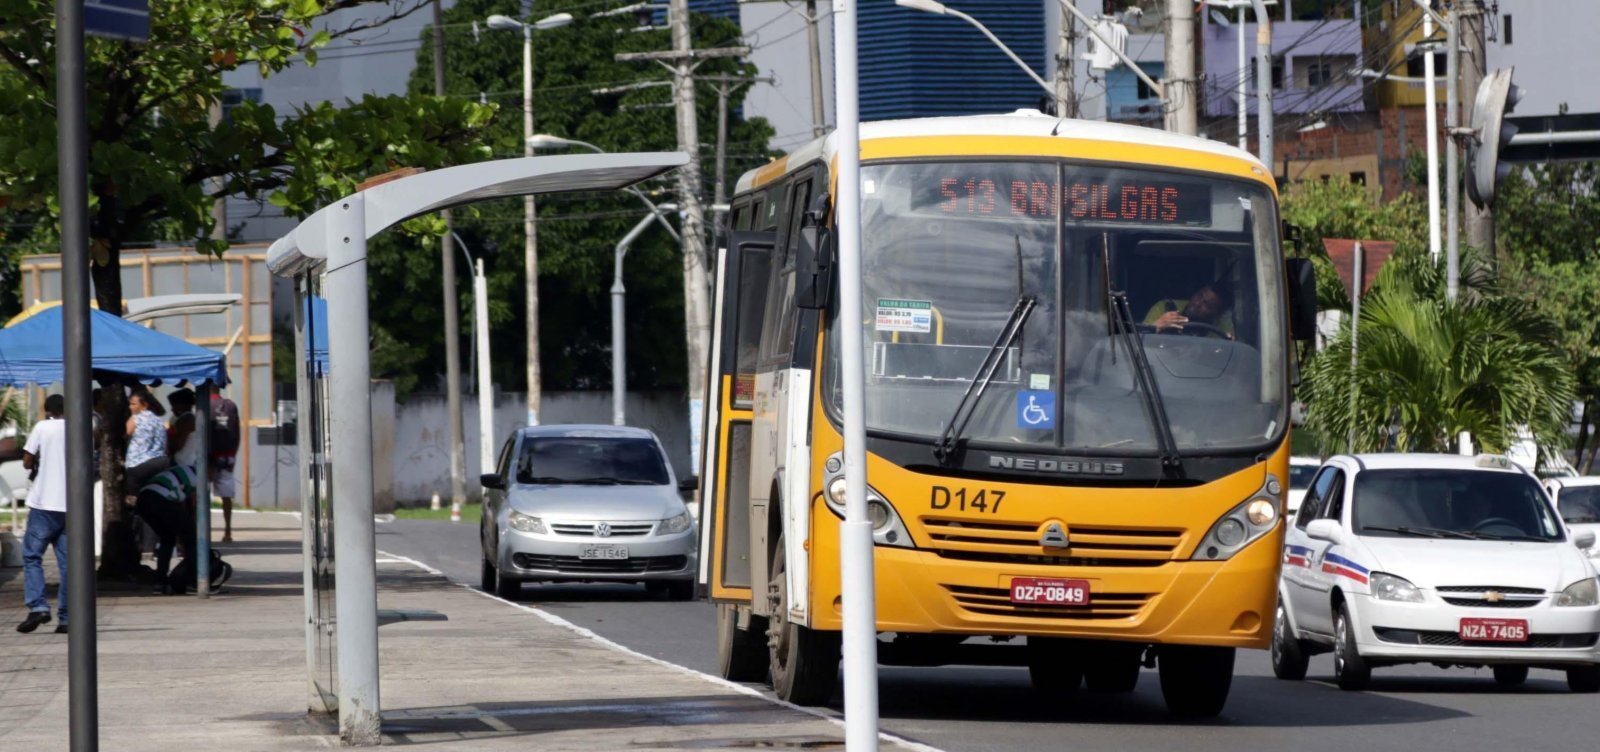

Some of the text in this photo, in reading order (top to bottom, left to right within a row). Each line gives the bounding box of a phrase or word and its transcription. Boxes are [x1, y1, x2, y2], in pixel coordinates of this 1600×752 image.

[941, 178, 995, 214] 513
[990, 456, 1124, 474] NEOBUS
[930, 485, 1006, 514] D147
